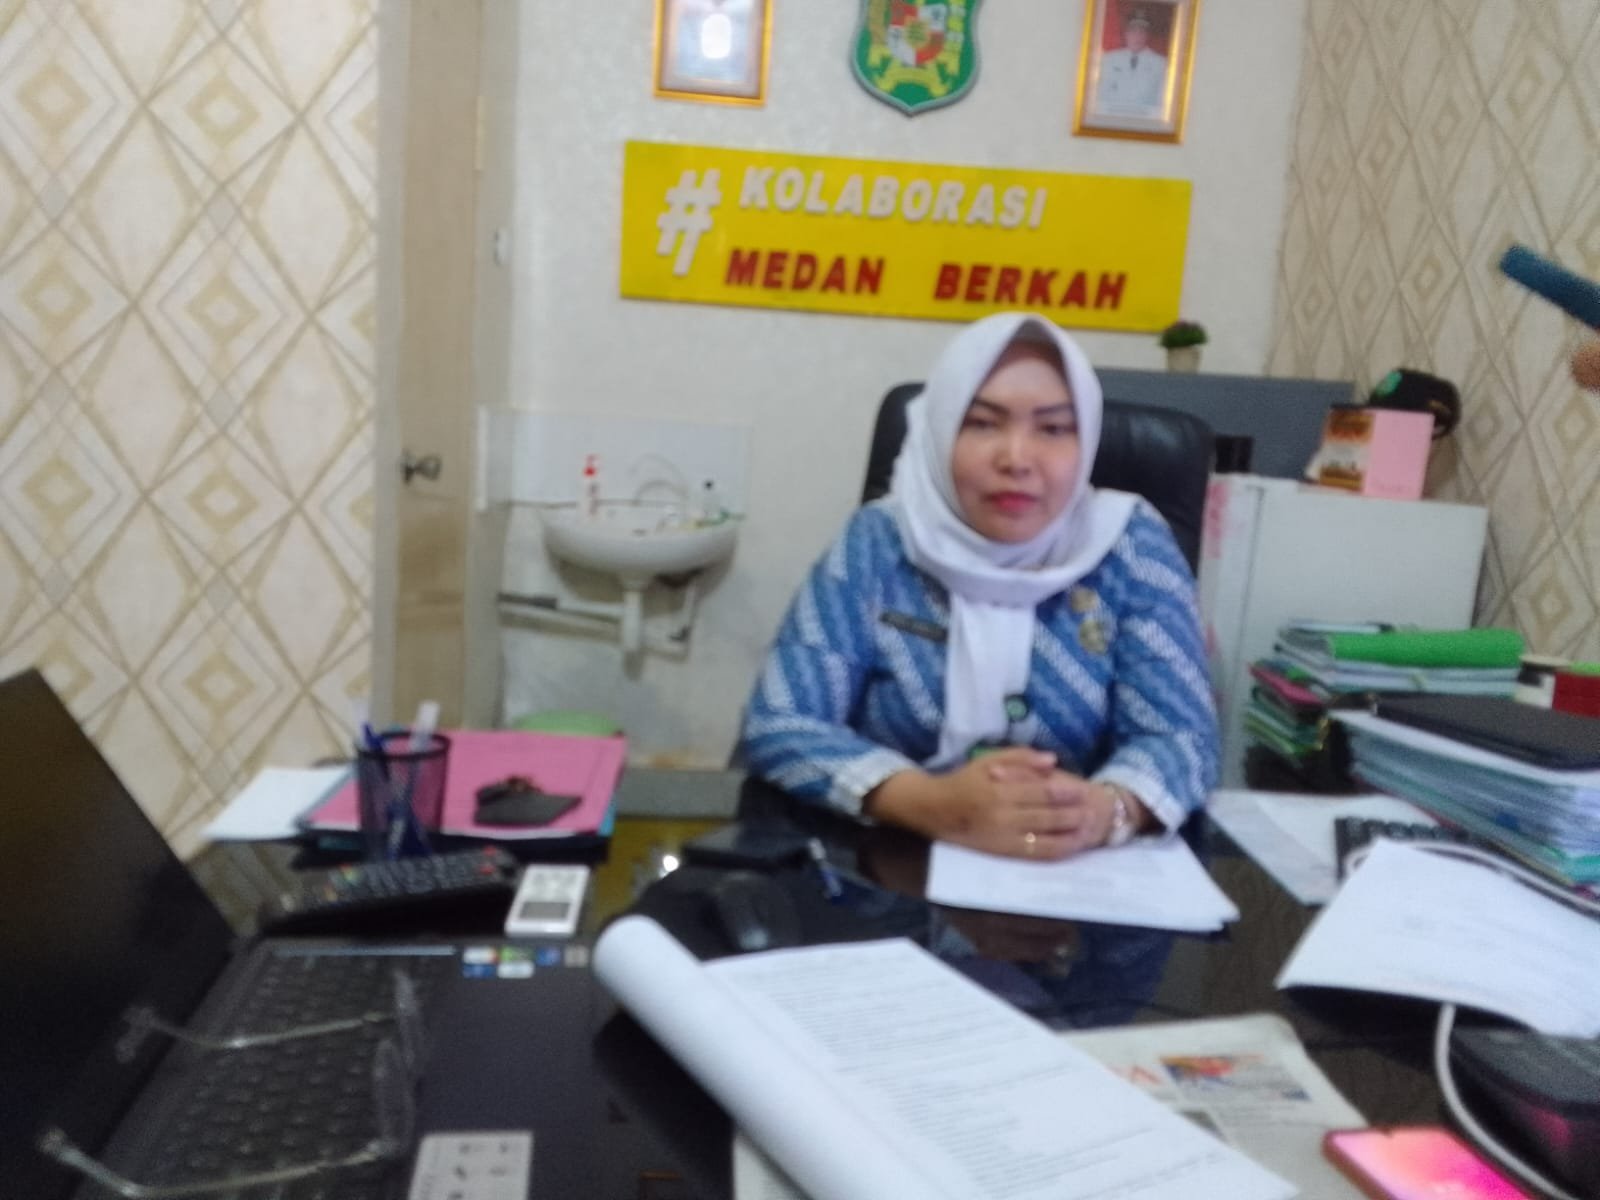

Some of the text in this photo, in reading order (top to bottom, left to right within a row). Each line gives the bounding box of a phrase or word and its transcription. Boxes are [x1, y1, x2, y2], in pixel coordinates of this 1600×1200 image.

[657, 166, 1047, 276] # KOLABORASI
[725, 248, 1126, 310] MEDAN BERKAH
